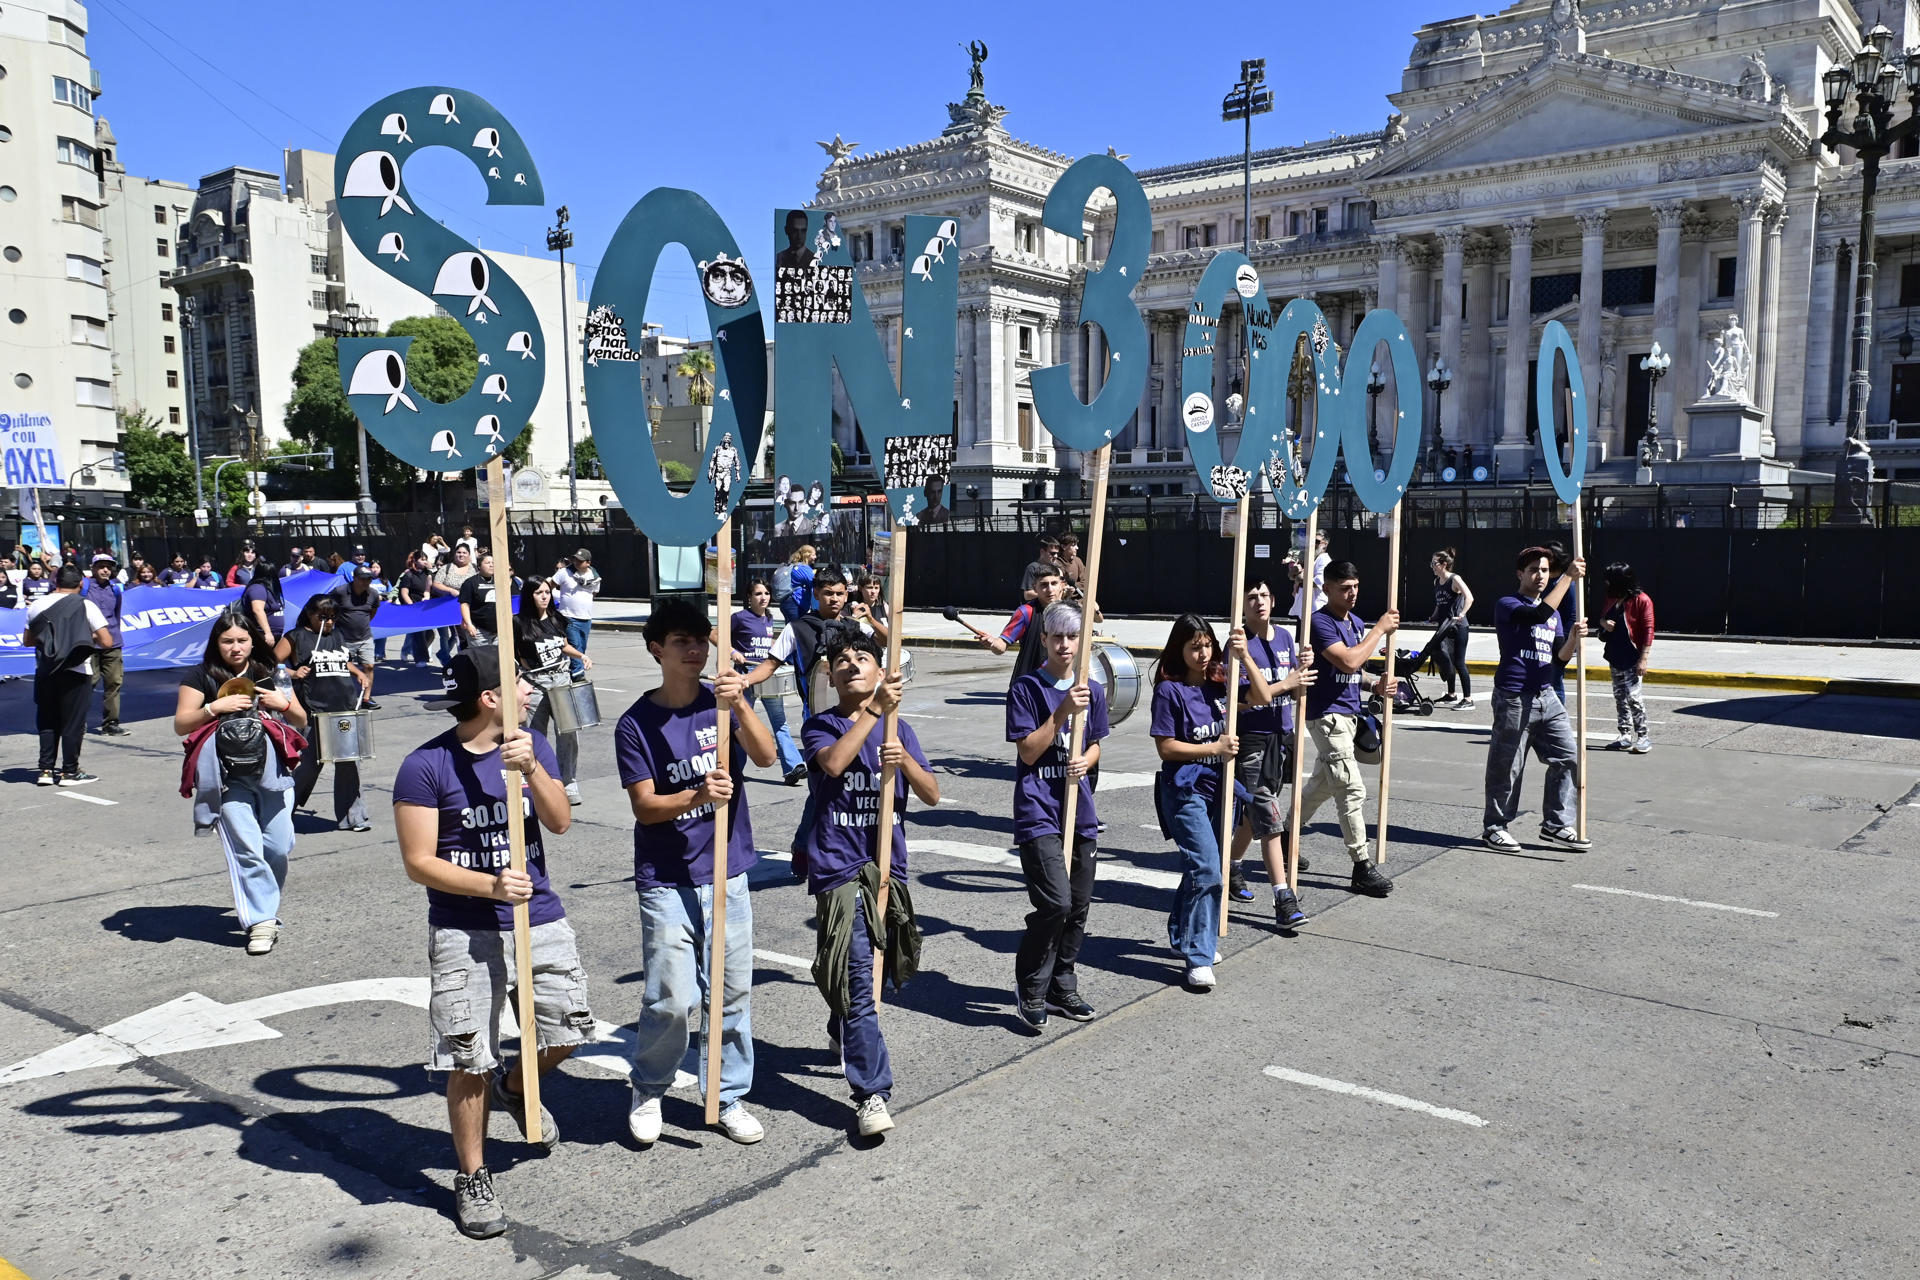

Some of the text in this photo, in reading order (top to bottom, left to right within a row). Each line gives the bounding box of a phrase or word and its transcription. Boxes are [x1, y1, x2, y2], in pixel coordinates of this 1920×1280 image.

[1567, 171, 1645, 193] NACIONAL
[334, 86, 960, 546] SON
[603, 312, 624, 326] No
[1246, 303, 1272, 331] NUNCA
[602, 326, 627, 337] nos
[601, 336, 628, 349] han
[587, 348, 641, 361] vencido
[0, 413, 51, 432] Quilmes
[12, 431, 36, 443] con
[4, 448, 65, 485] AXEL
